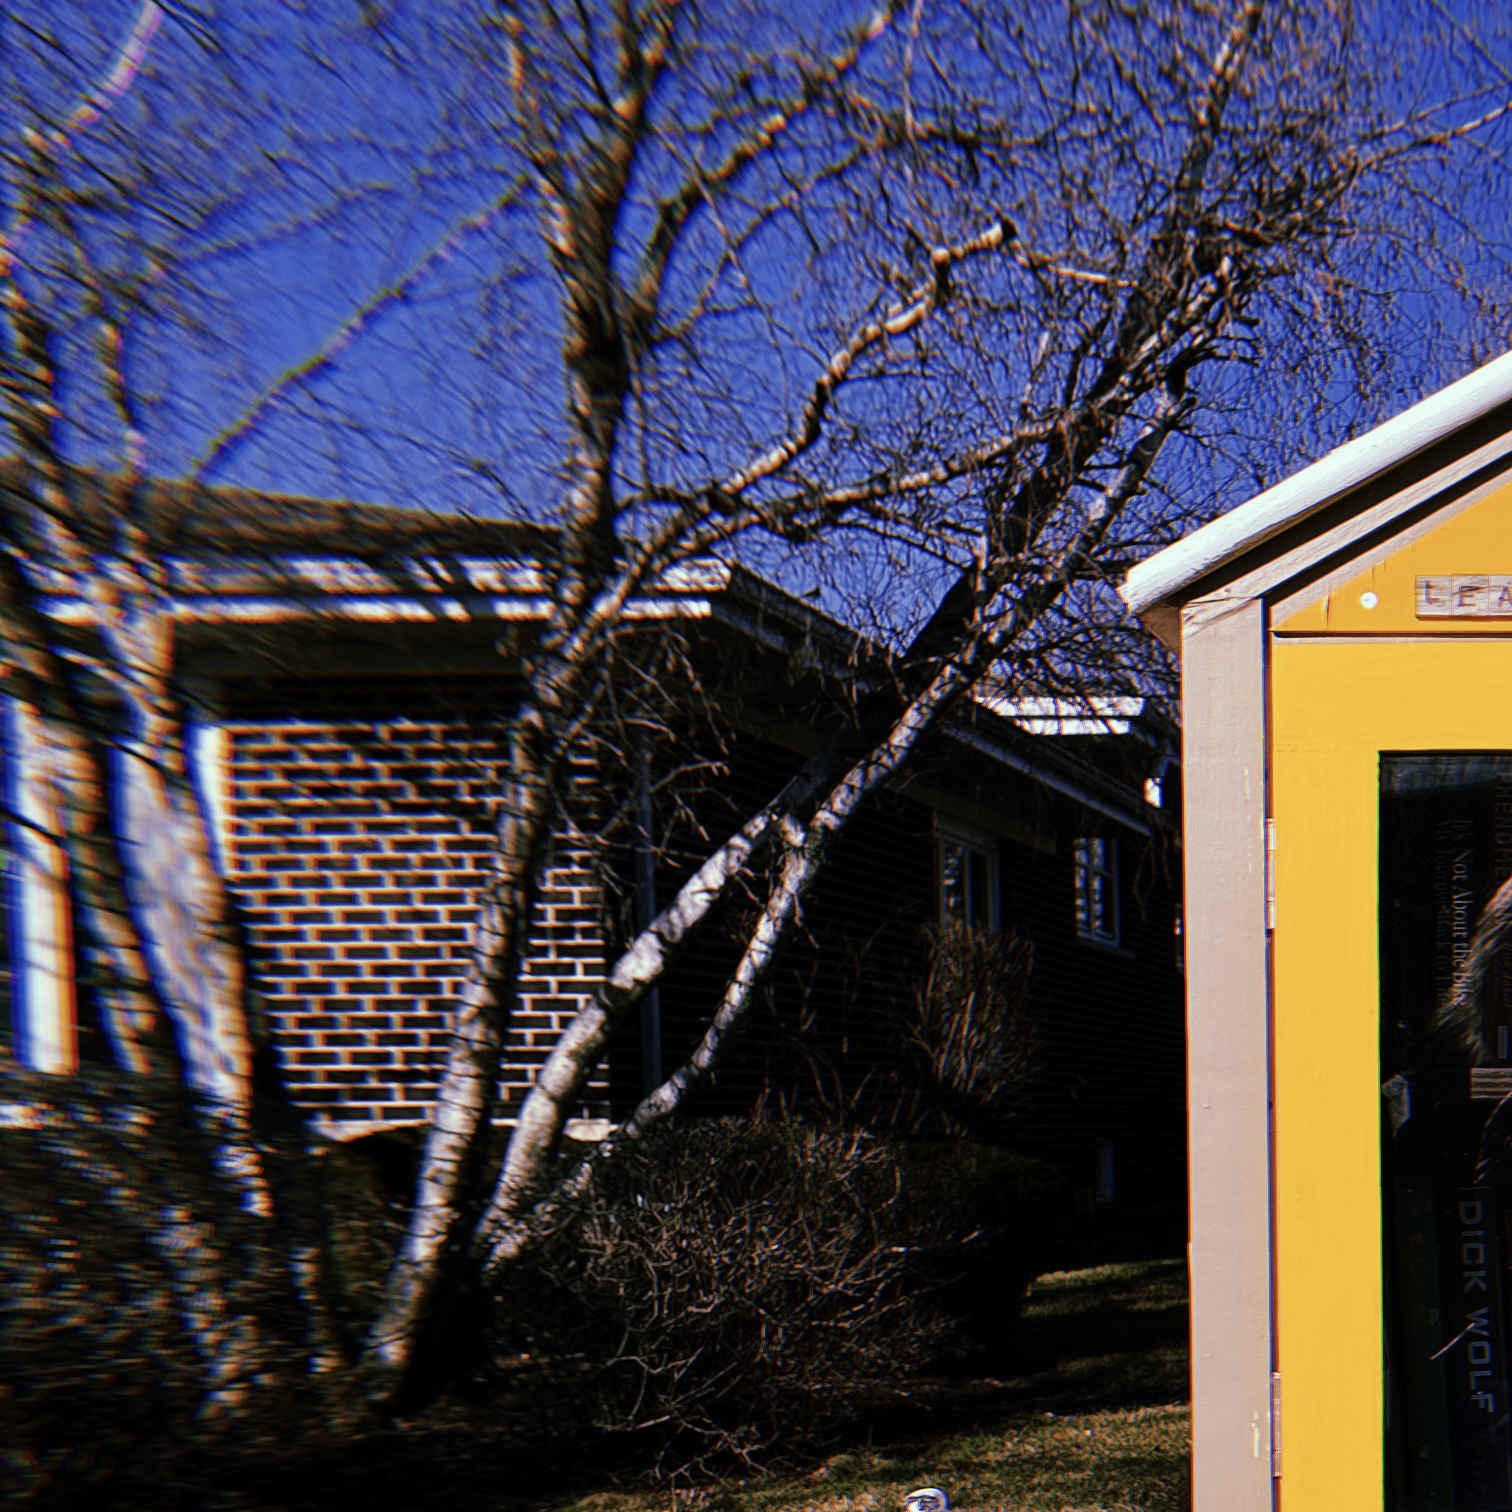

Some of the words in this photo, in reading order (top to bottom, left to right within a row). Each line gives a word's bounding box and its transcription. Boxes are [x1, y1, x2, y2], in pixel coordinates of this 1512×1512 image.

[1453, 847, 1474, 882] Not
[1452, 886, 1474, 938] About
[1452, 942, 1474, 969] the
[1457, 1200, 1490, 1296] DICK
[1464, 1306, 1496, 1415] WOLF
